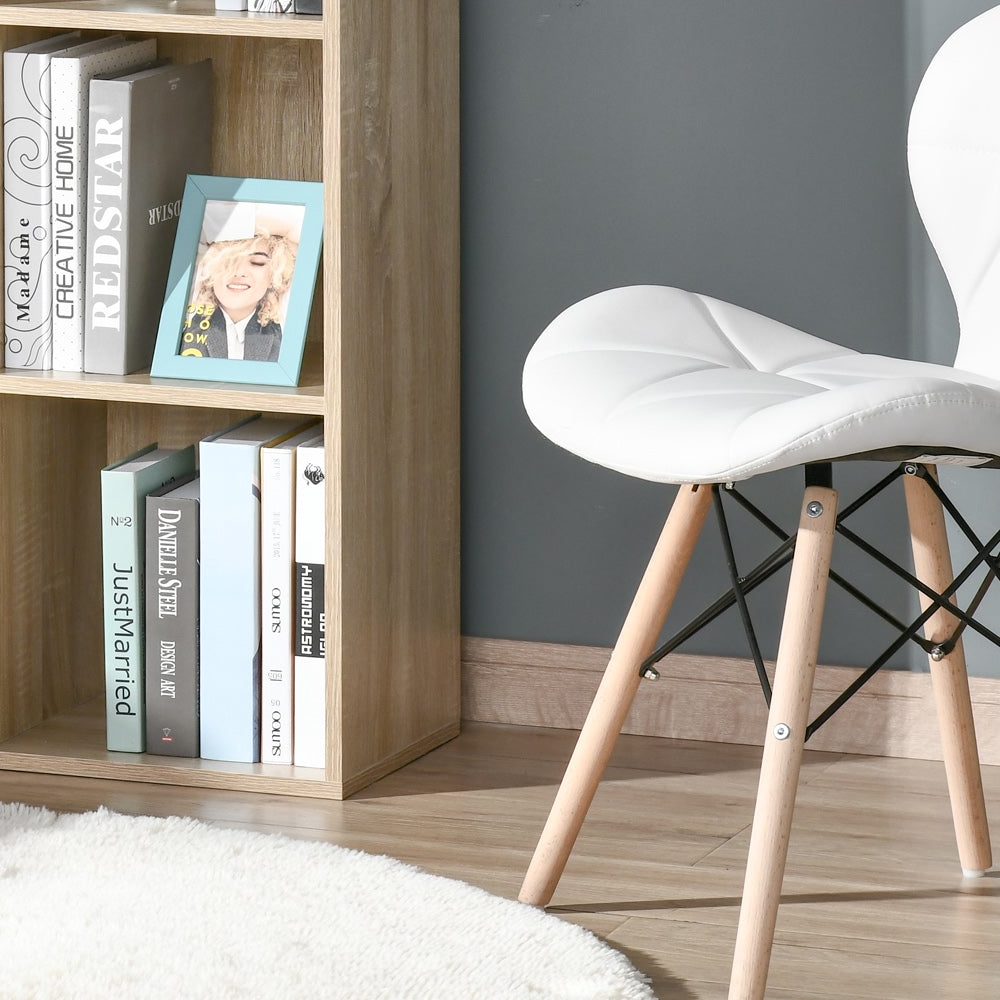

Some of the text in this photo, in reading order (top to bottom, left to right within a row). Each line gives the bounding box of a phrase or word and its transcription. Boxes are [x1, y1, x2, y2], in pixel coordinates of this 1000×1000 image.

[55, 126, 74, 320] CREATIVE HOME
[91, 116, 124, 332] REDSTAR
[16, 218, 30, 322] Madame
[157, 508, 182, 576] DANIELLE
[157, 577, 182, 619] STEEL
[300, 564, 313, 655] ASTRONOMY
[160, 640, 176, 699] DESIGN ART
